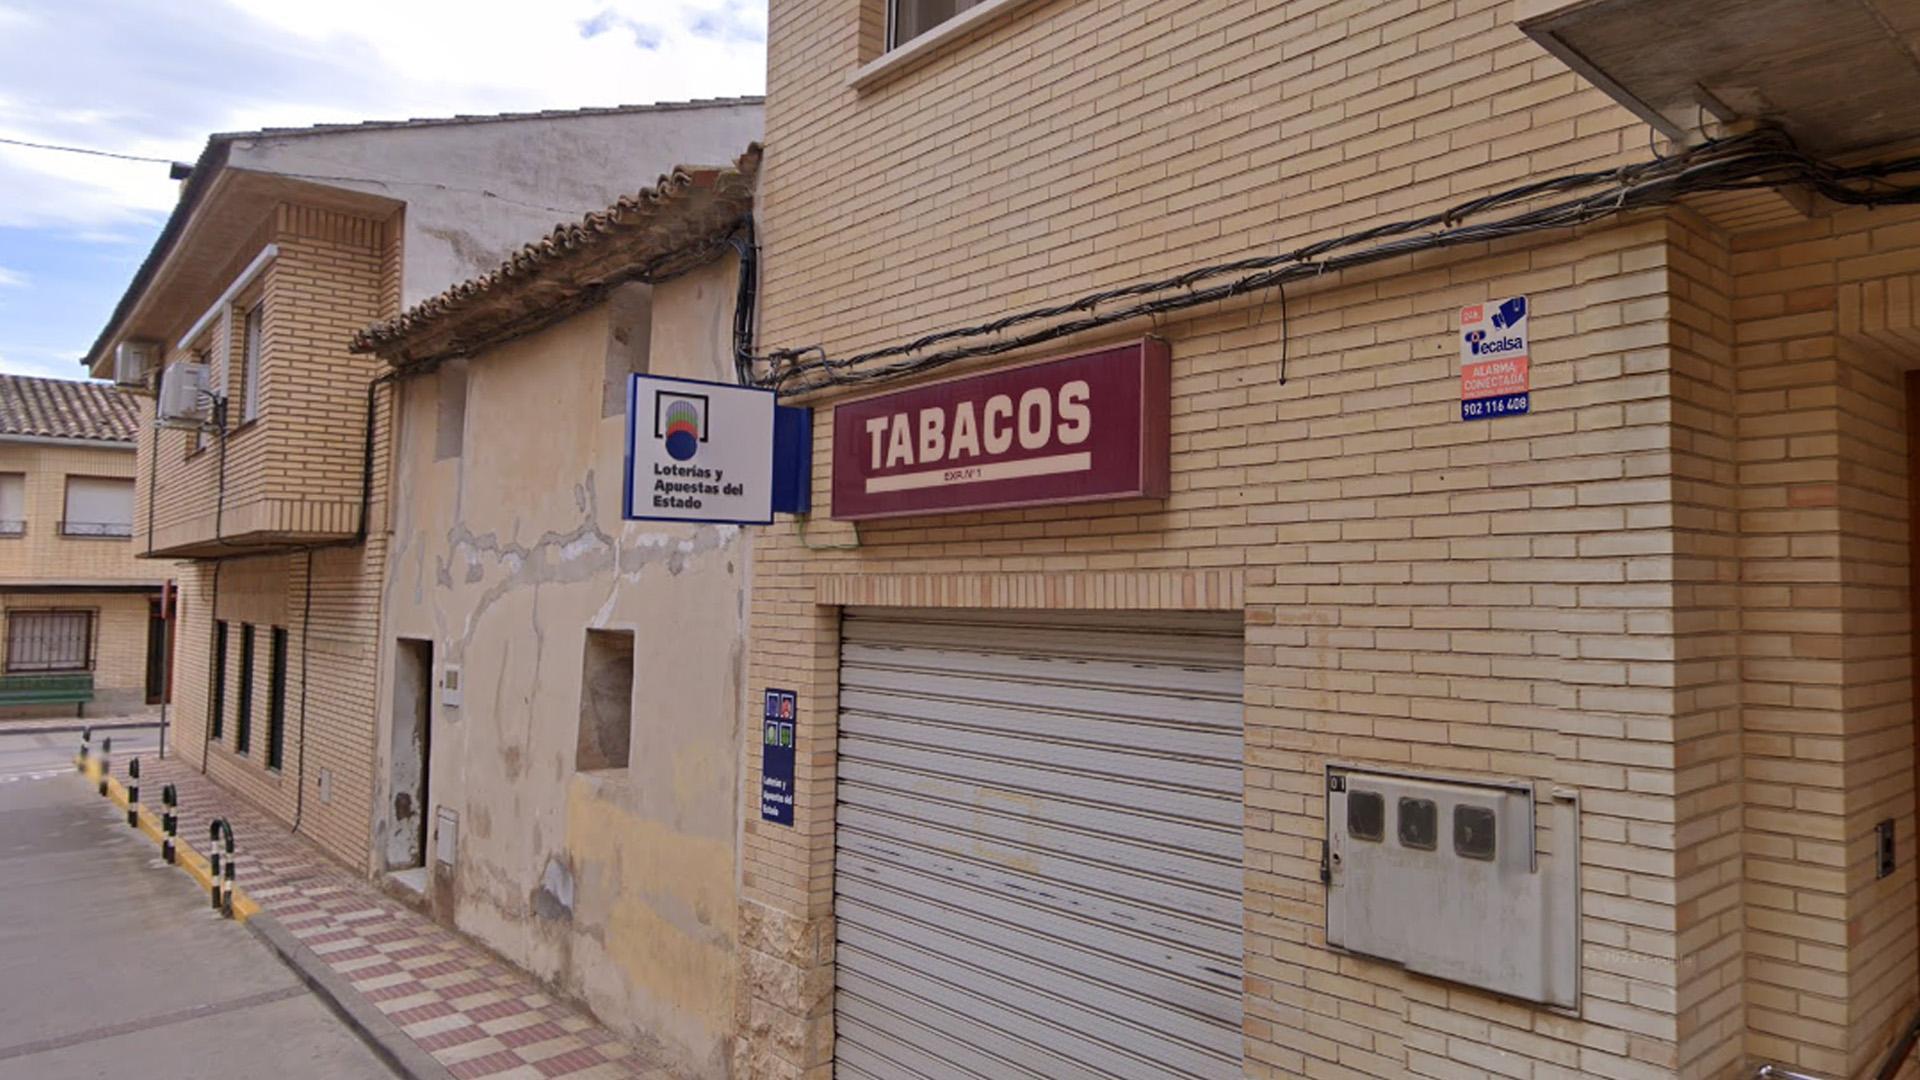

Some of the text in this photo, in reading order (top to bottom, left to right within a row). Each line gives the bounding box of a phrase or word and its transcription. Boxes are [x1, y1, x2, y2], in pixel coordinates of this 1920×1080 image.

[1464, 330, 1523, 355] Tecalsa
[1473, 362, 1516, 377] ALARMA
[1465, 375, 1524, 390] CONECTADA
[1463, 402, 1482, 416] 902
[1485, 400, 1505, 413] 116
[866, 380, 1091, 470] TABACOS
[654, 463, 723, 482] Loterías y
[654, 479, 743, 496] Apuestas del
[653, 495, 702, 509] Estado
